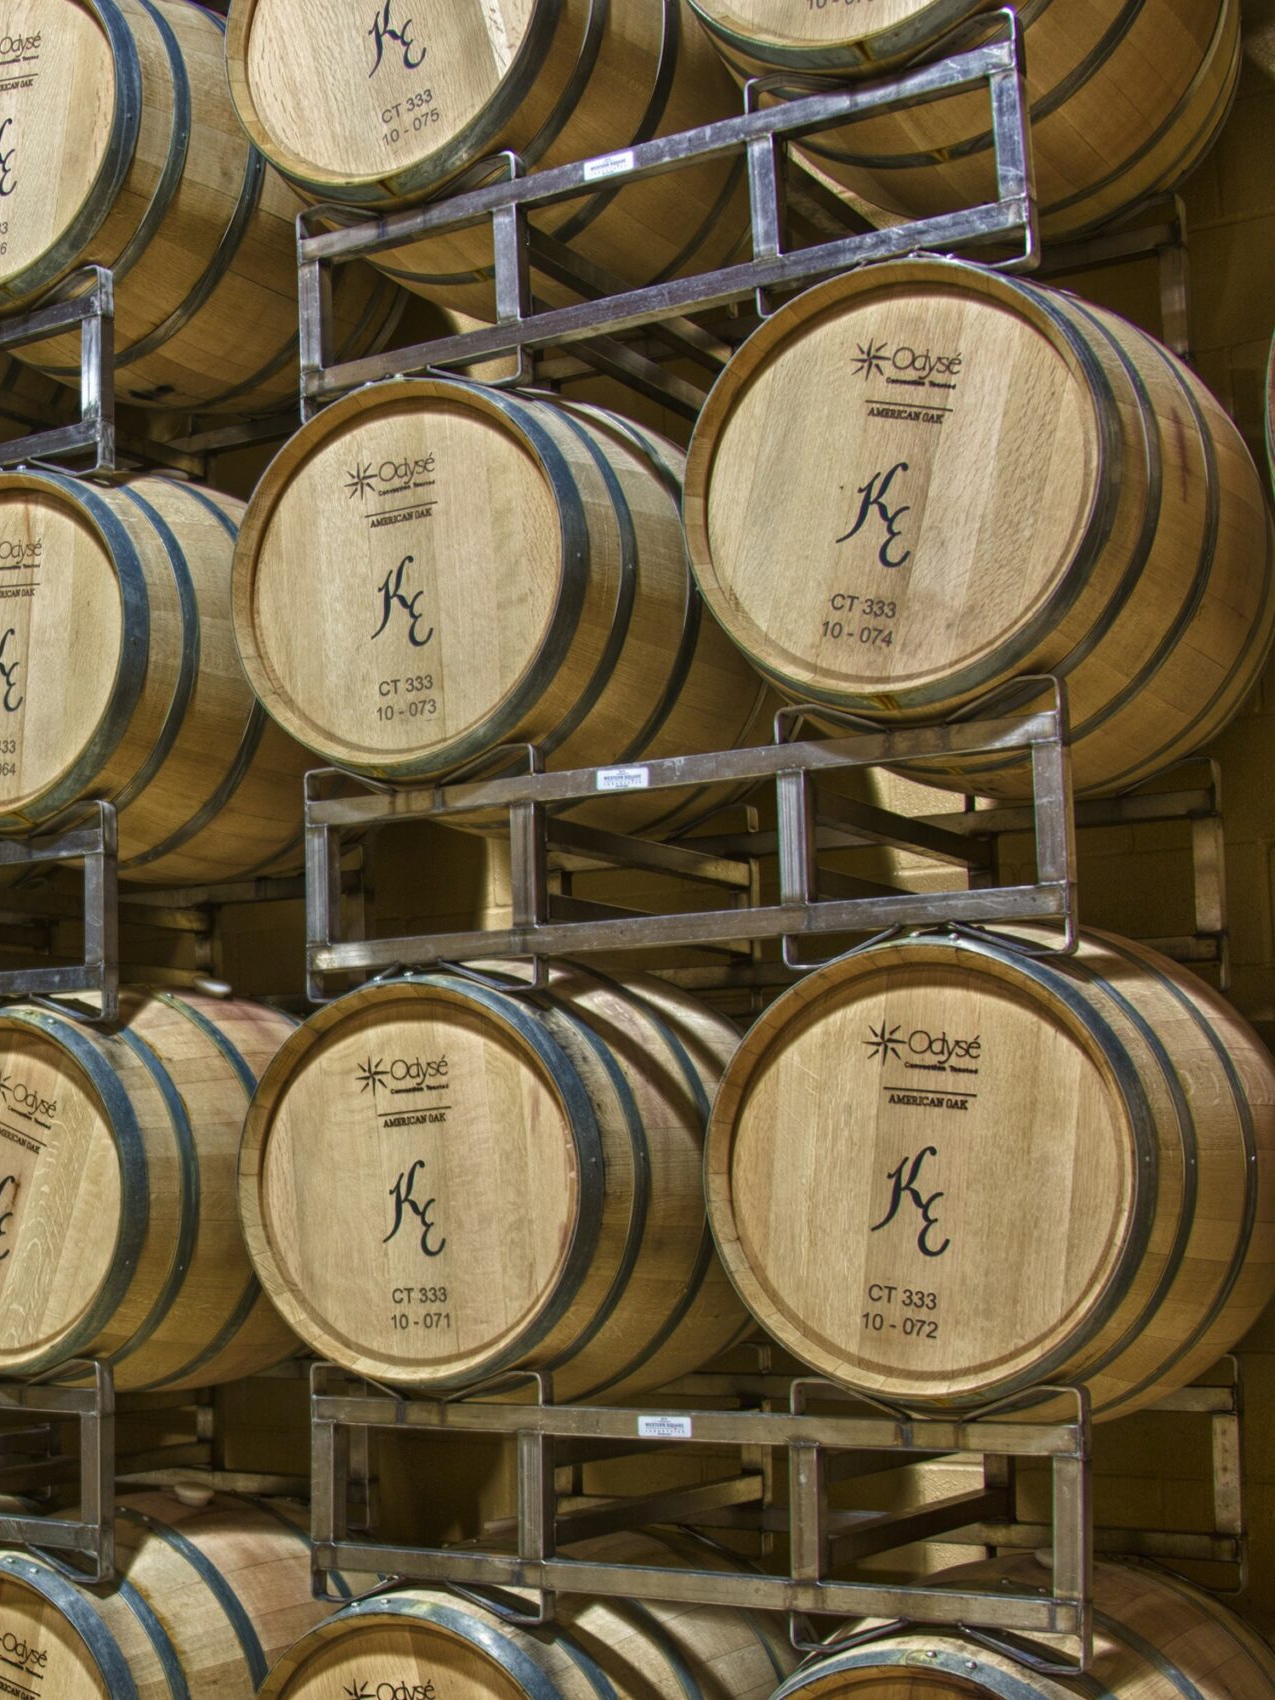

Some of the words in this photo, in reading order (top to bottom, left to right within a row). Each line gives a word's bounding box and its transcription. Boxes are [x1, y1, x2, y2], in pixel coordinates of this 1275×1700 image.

[0, 30, 42, 58] Odysé
[381, 104, 402, 124] CT
[407, 89, 433, 111] 333
[382, 129, 399, 146] 10
[412, 108, 440, 131] 075
[892, 347, 962, 379] Odysé
[867, 407, 920, 421] AMERICAN
[922, 414, 944, 424] OAK
[378, 452, 435, 485] Odysé
[370, 511, 414, 529] AMERICAN
[836, 462, 911, 568] KE
[371, 554, 433, 647] KE
[831, 593, 859, 612] CT
[862, 599, 897, 618] 333
[822, 620, 842, 639] 10
[860, 627, 893, 646] 074
[378, 679, 401, 697] CT
[405, 674, 433, 693] 333
[376, 704, 394, 722] 10
[409, 698, 437, 718] 073
[908, 1030, 981, 1064] Odysé
[390, 1054, 449, 1086] Odysé
[13, 1084, 58, 1118] Odysé
[888, 1094, 944, 1109] AMERICAN
[946, 1097, 968, 1111] OAK
[383, 1114, 428, 1128] AMERICAN
[429, 1112, 447, 1124] OAK
[383, 1159, 446, 1257] KE
[871, 1145, 951, 1258] KE
[392, 1289, 415, 1304] CT
[419, 1287, 447, 1303] 333
[868, 1284, 897, 1304] CT
[902, 1289, 937, 1310] 333
[391, 1313, 409, 1330] 10
[424, 1312, 451, 1329] 071
[862, 1312, 883, 1331] 10
[903, 1319, 938, 1338] 072
[2, 1633, 48, 1668] Odysé
